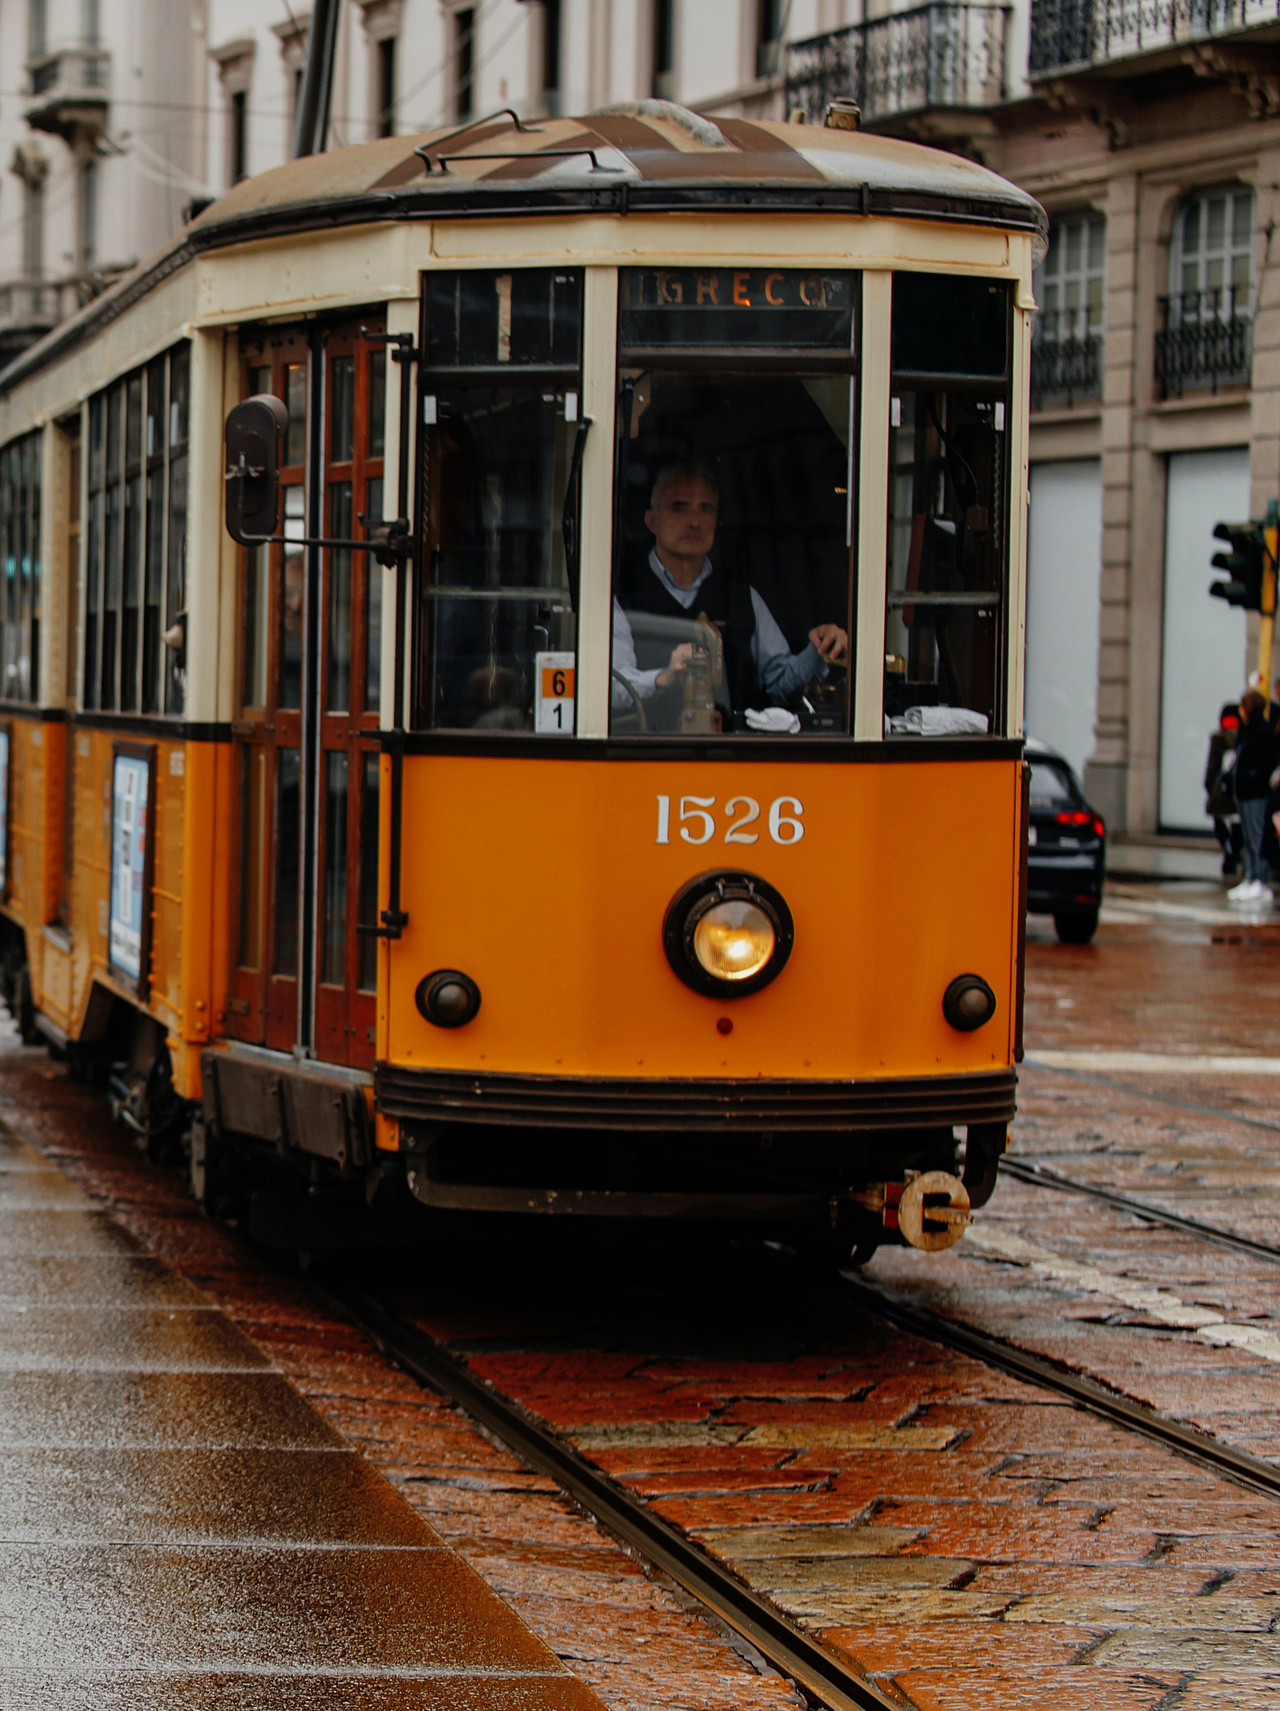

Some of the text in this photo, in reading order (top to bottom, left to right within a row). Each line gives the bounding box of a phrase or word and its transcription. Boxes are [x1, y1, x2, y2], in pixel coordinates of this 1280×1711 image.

[658, 272, 825, 307] GRECO
[552, 670, 566, 696] 6
[552, 703, 562, 729] 1
[655, 795, 805, 845] 1526
